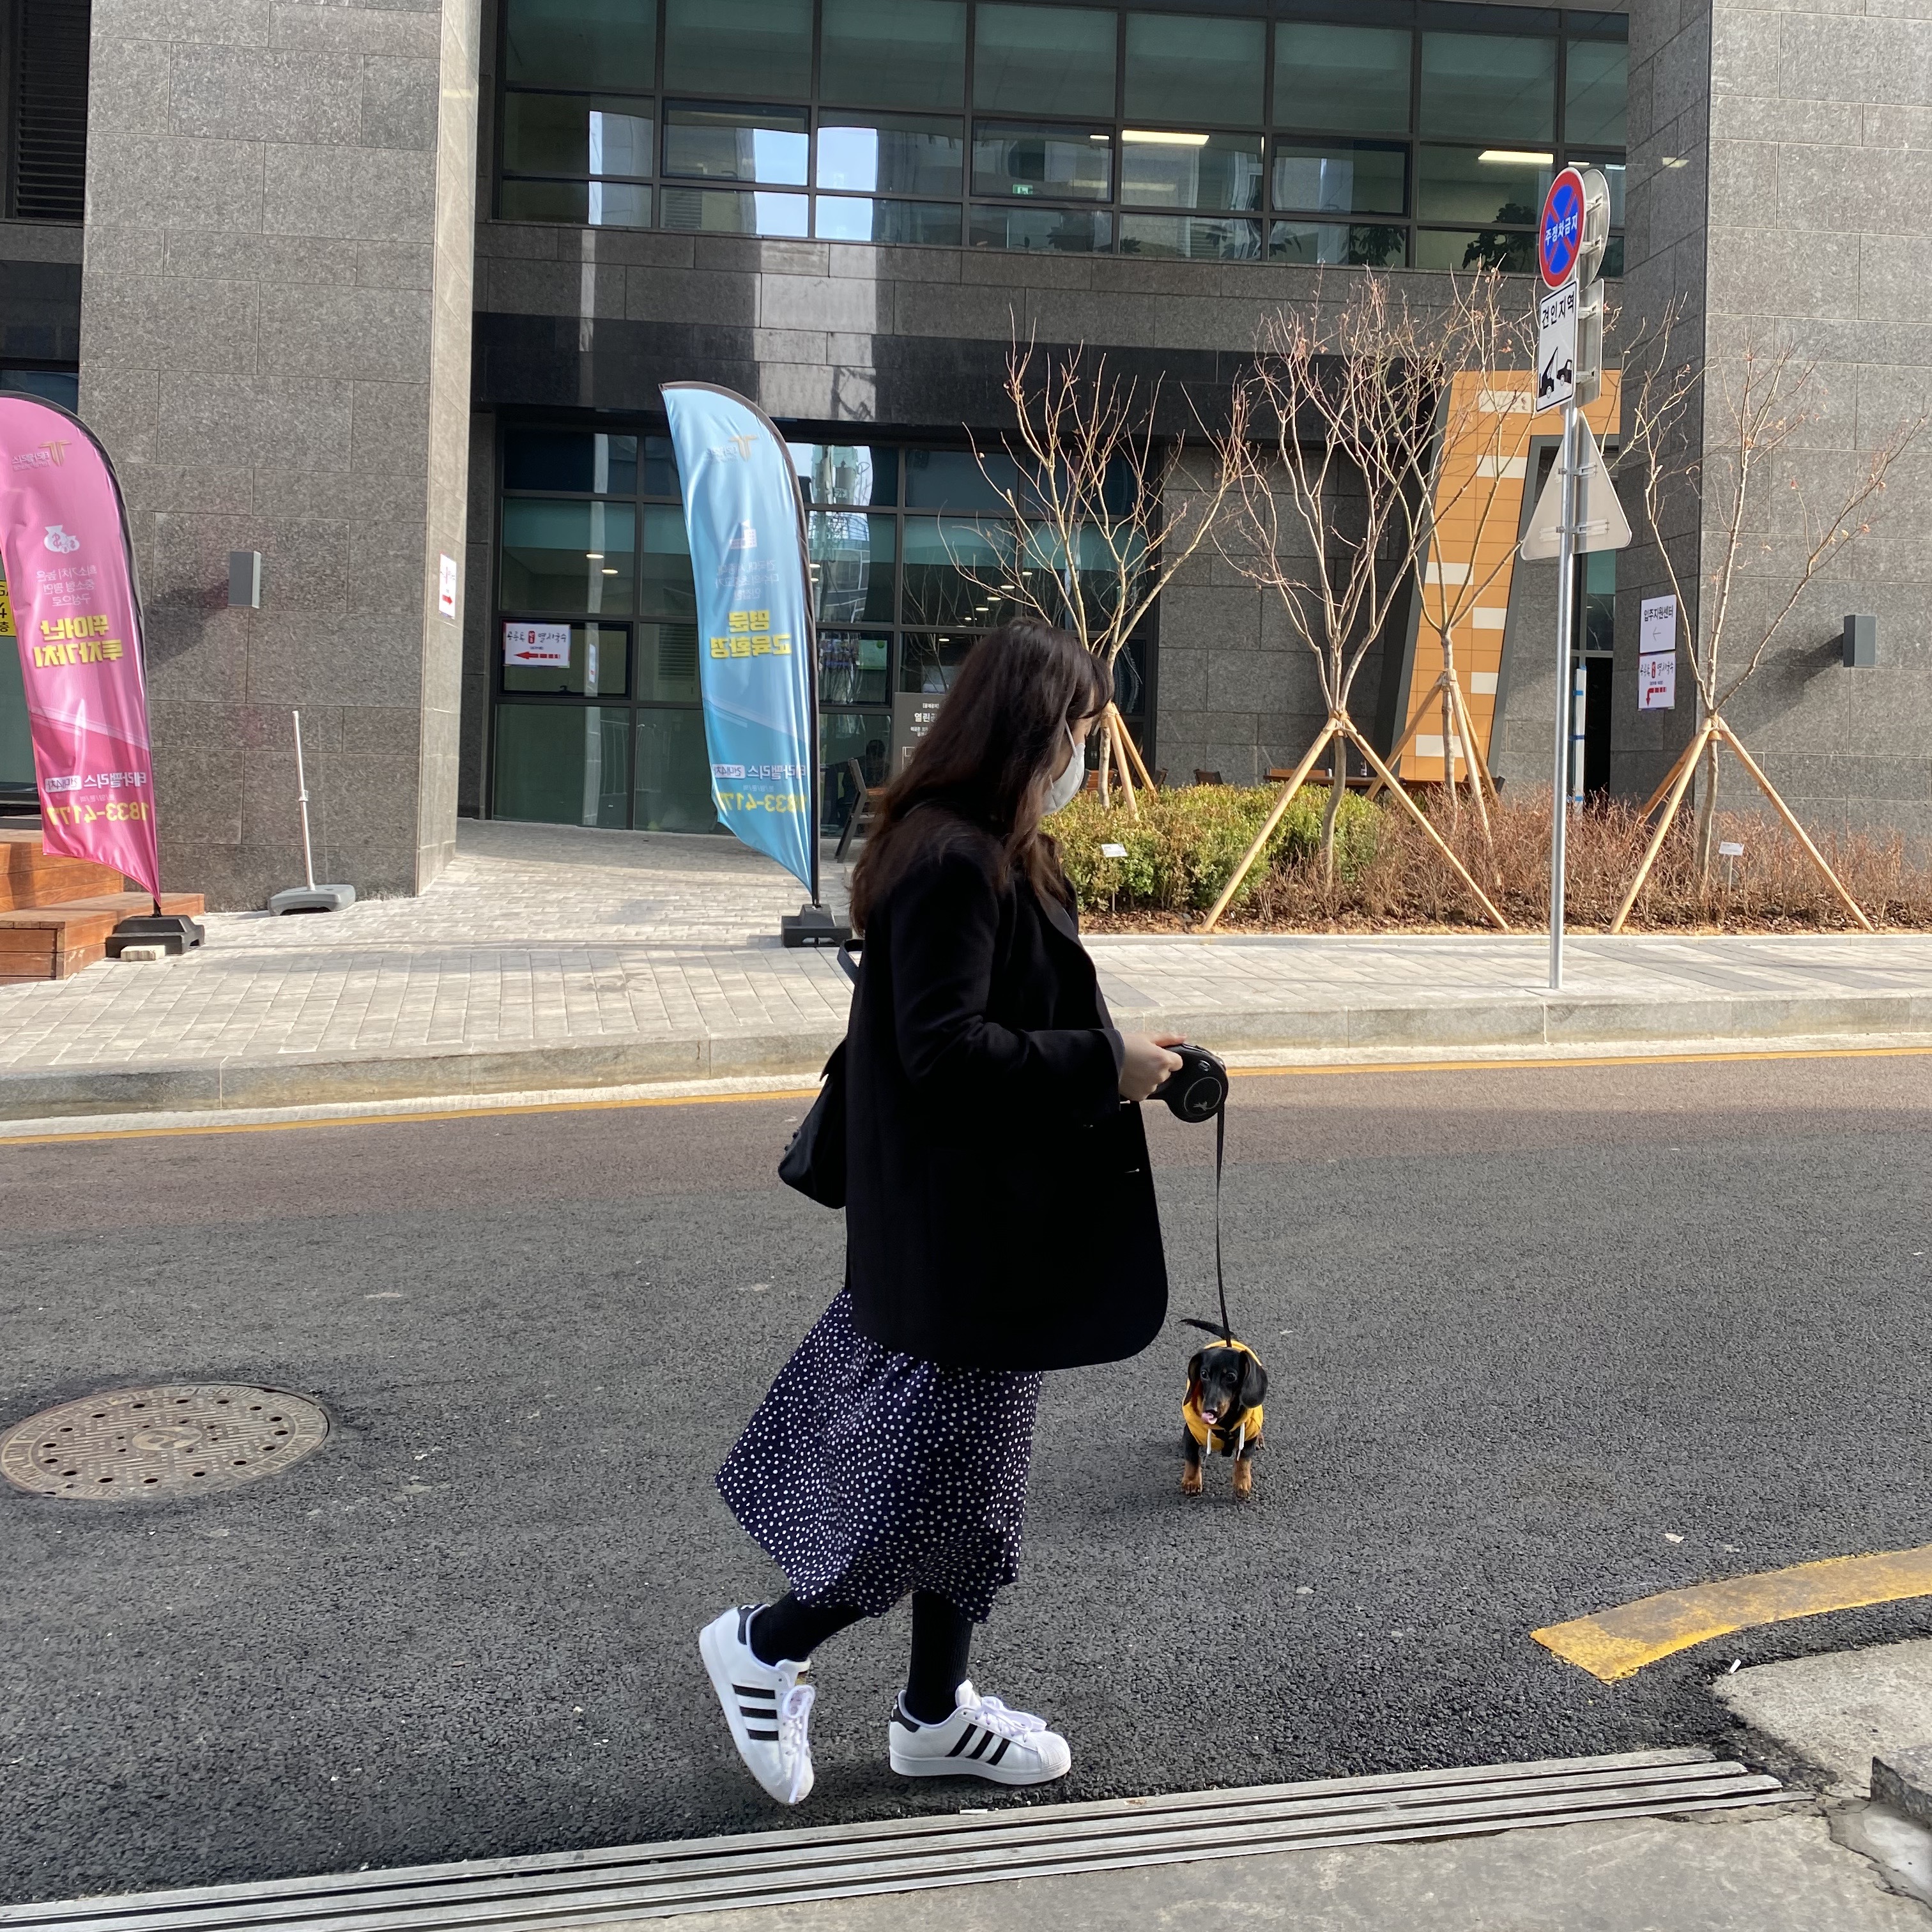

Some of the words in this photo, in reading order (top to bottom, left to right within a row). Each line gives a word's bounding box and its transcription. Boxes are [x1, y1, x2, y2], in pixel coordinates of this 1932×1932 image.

[1545, 212, 1578, 246] 주정차금지
[1542, 291, 1575, 330] 견인지역
[1644, 605, 1673, 622] 입주지원센터
[202, 1386, 263, 1399] SEOUL
